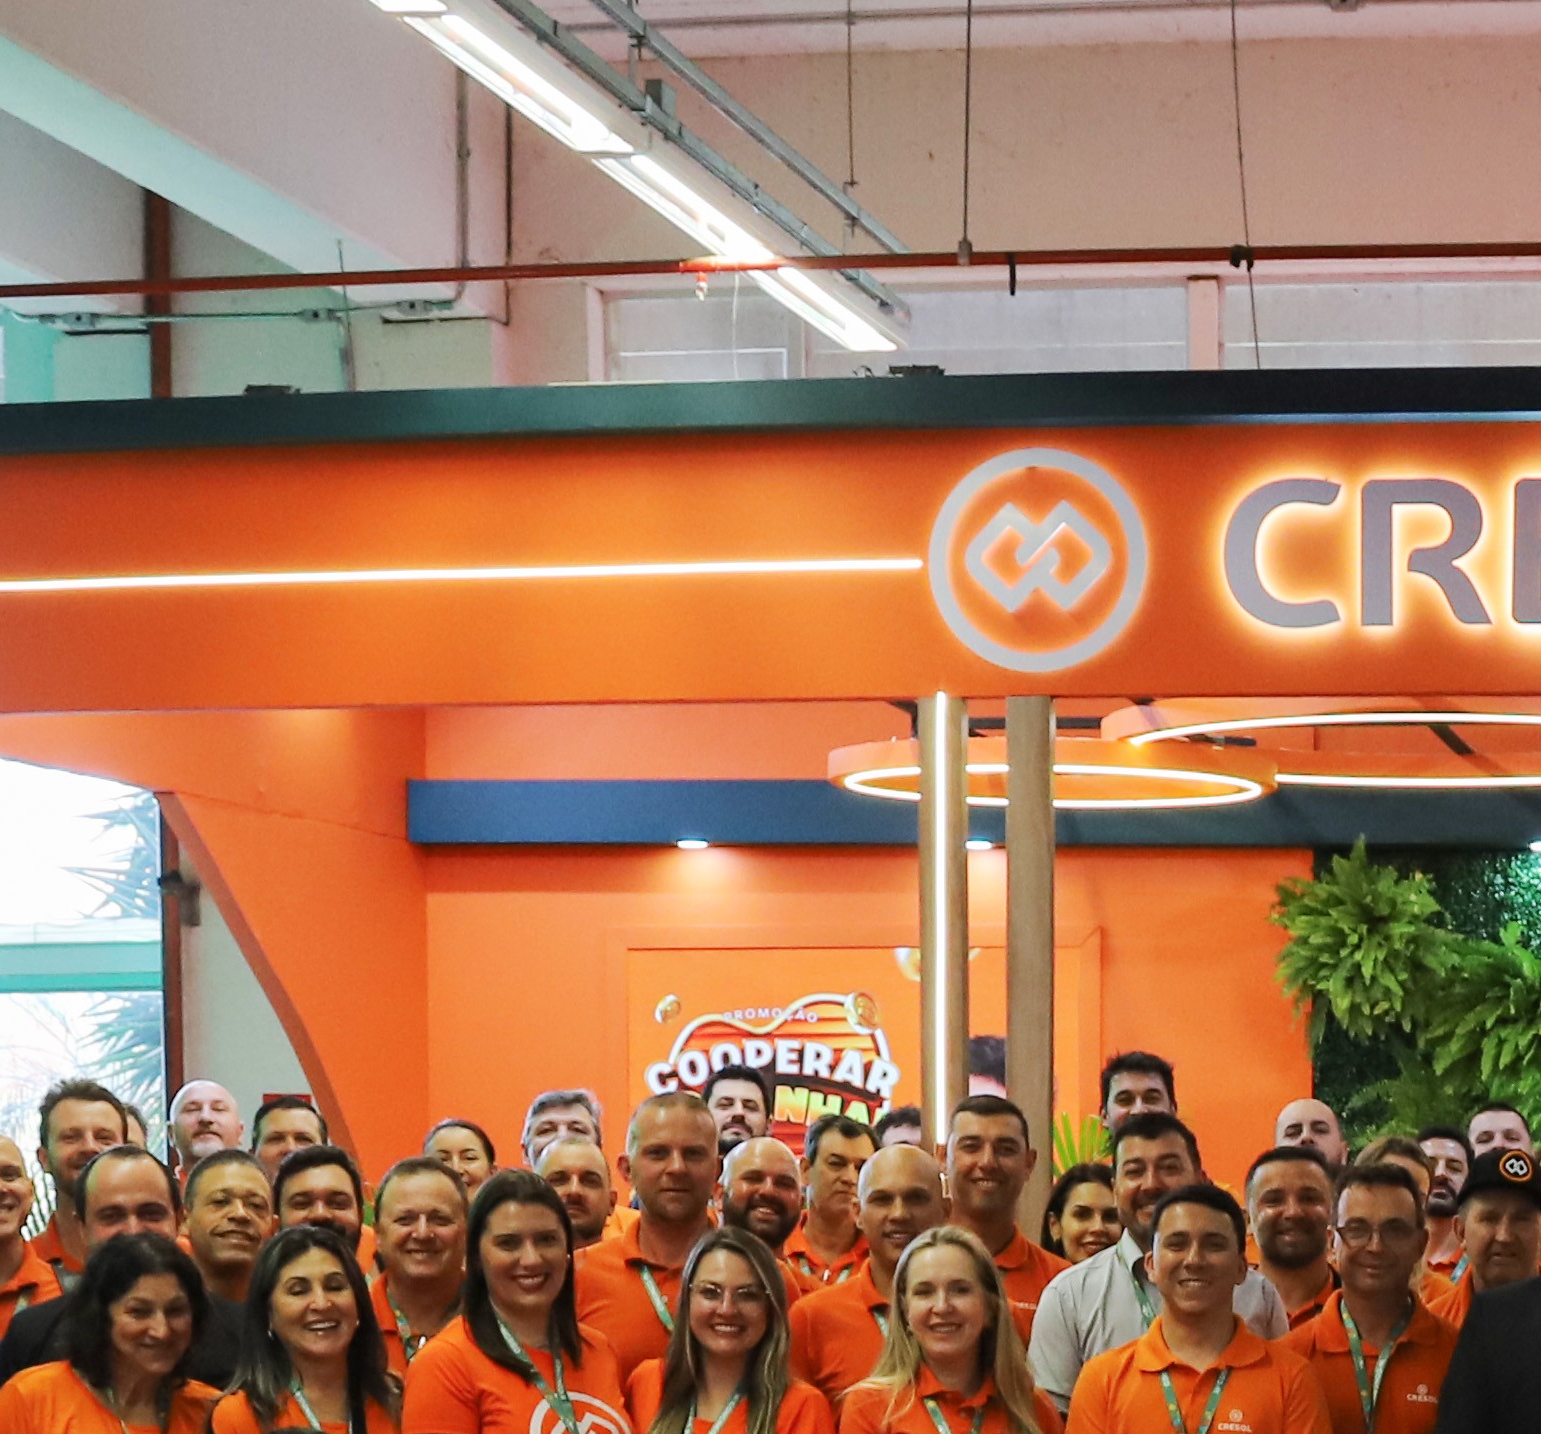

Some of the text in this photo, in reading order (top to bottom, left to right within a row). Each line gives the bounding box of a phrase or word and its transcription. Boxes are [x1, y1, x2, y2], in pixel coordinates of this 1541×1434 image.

[723, 1006, 819, 1024] PROMOÃO
[645, 1037, 900, 1097] COOPERAR
[1217, 1422, 1253, 1433] CRESOL
